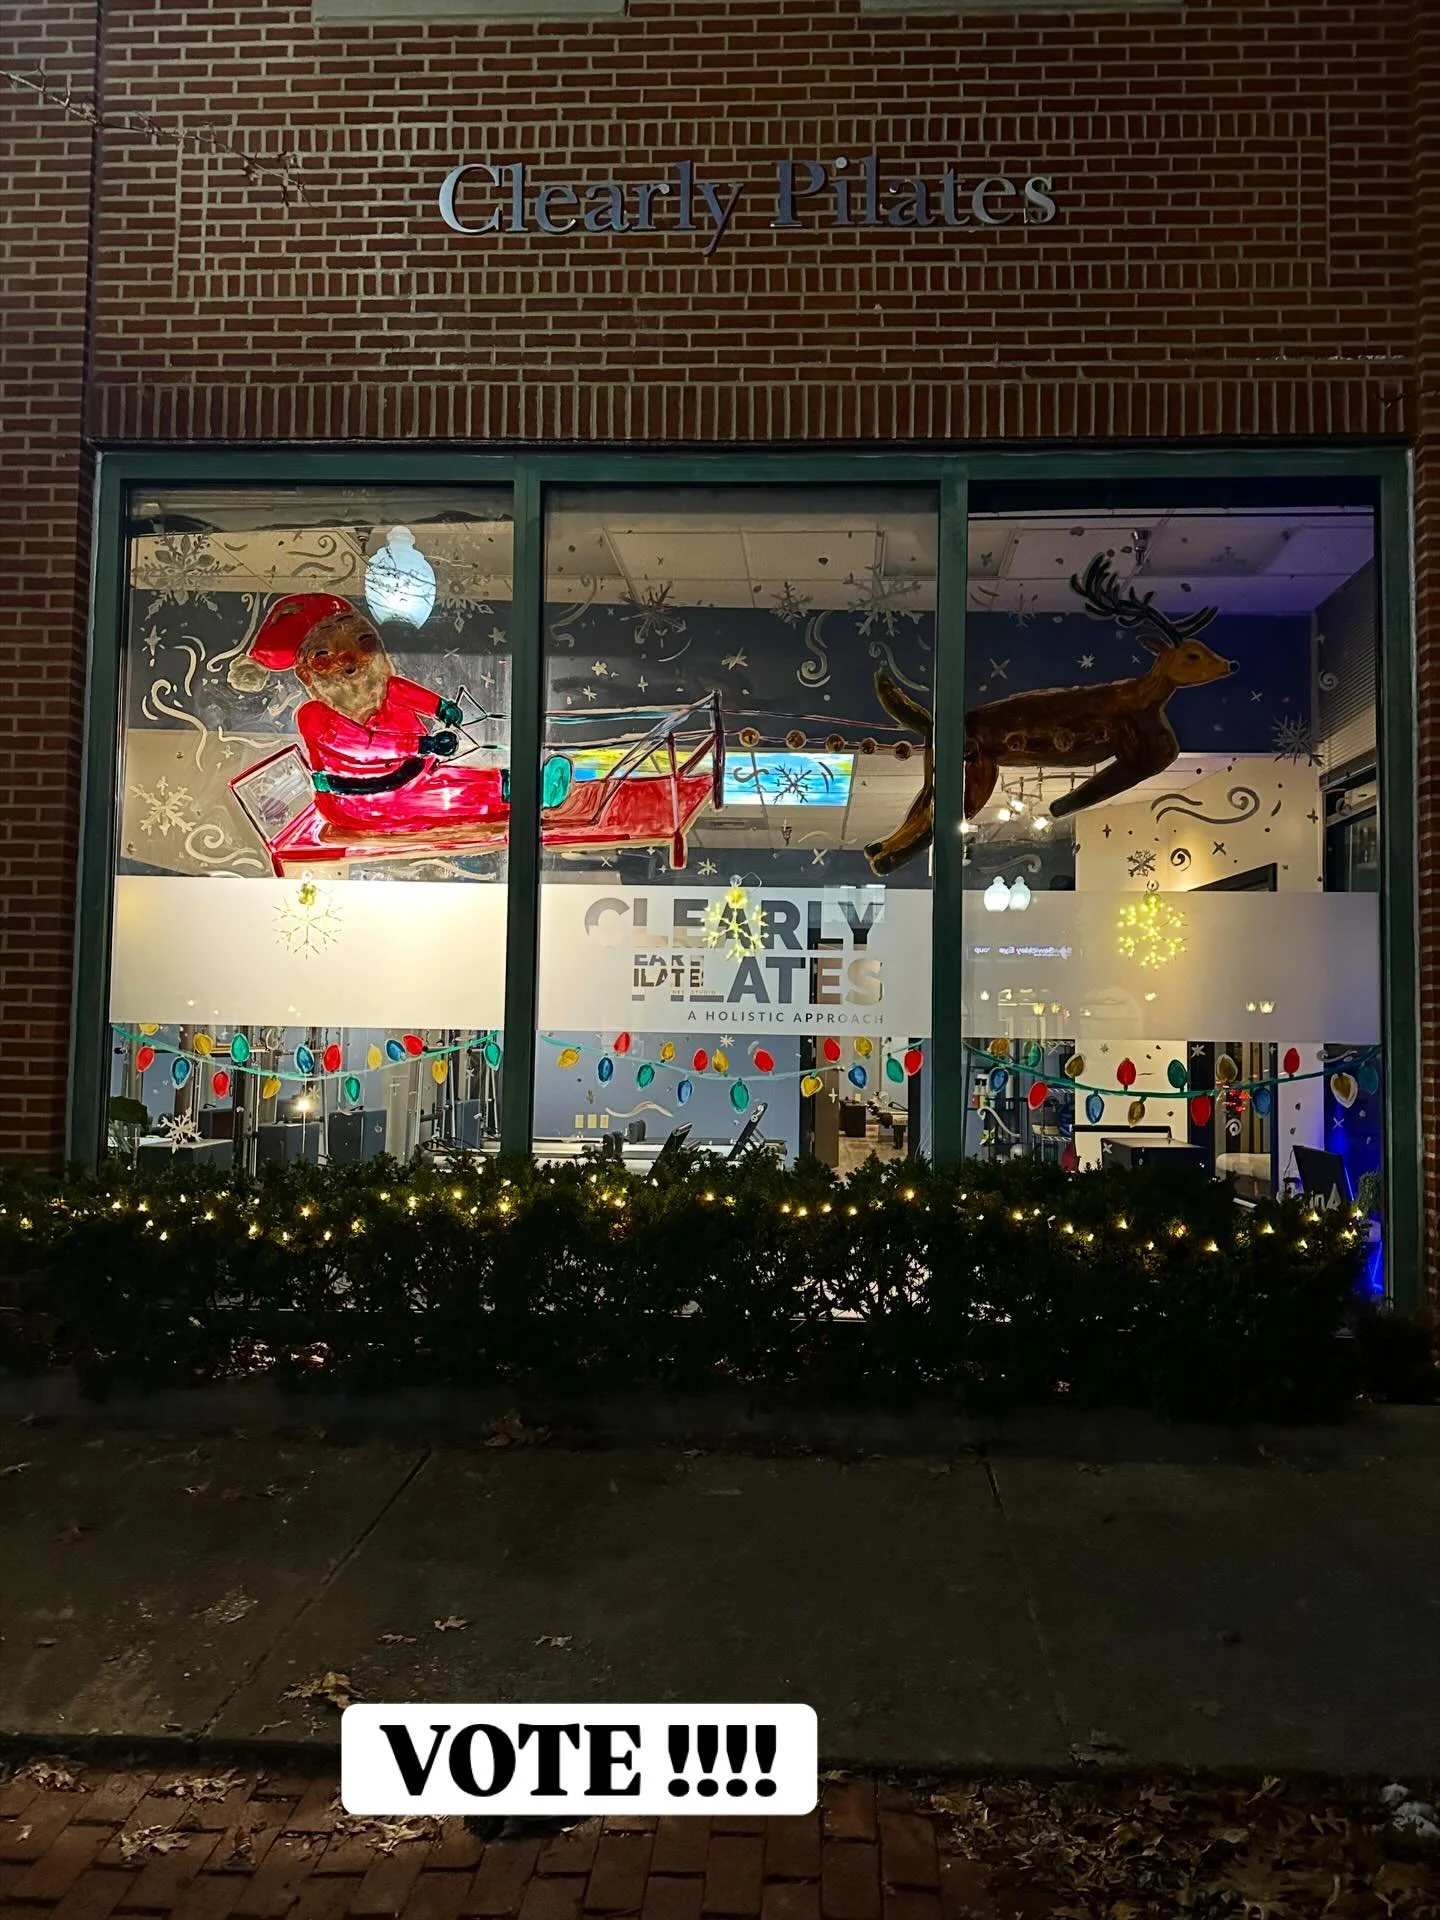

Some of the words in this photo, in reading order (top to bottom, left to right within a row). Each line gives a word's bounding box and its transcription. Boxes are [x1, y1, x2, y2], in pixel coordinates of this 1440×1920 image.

[439, 159, 744, 256] Clearly
[769, 154, 1060, 229] Pilates
[584, 897, 885, 951] CLEARLY
[687, 1010, 697, 1021] A
[705, 1011, 785, 1023] HOLISTIC
[792, 1012, 885, 1025] APPROACH
